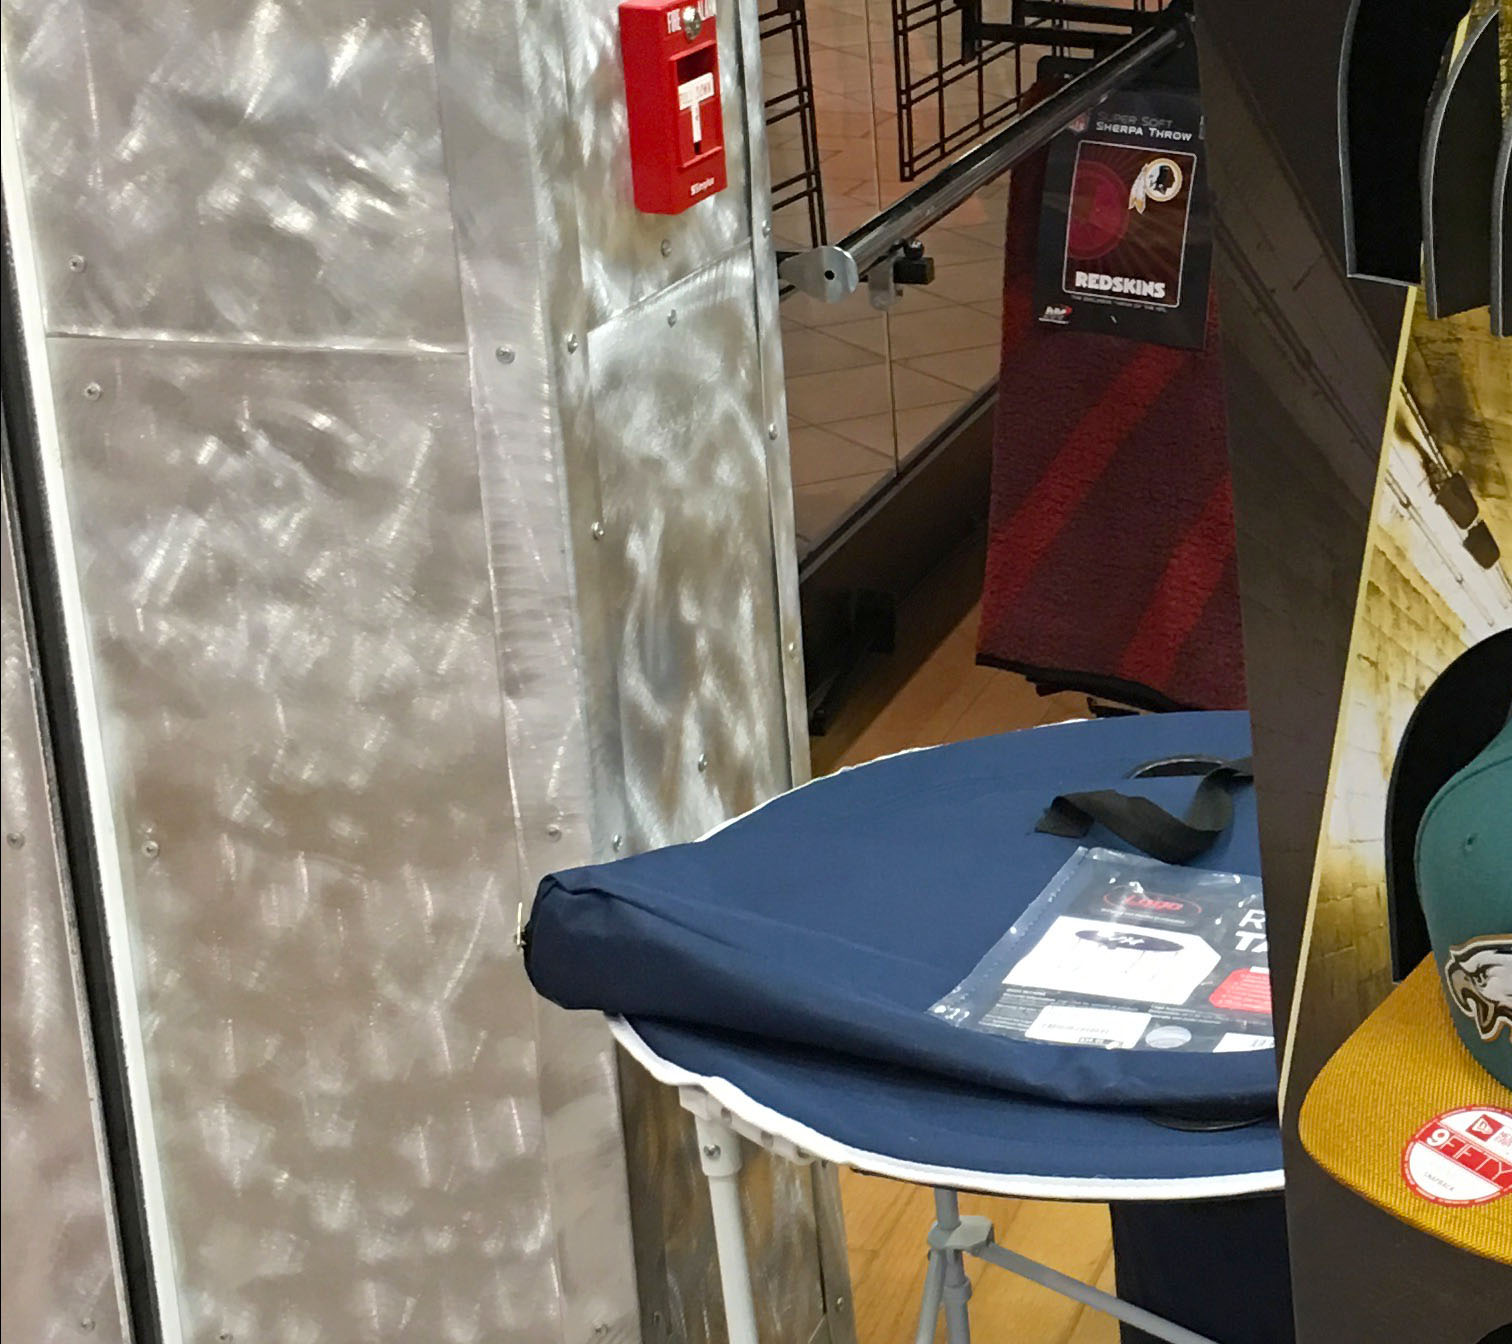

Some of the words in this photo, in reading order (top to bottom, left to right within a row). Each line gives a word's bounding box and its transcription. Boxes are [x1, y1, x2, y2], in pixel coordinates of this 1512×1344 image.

[1096, 121, 1144, 136] SHERPA
[1149, 127, 1193, 142] THROW
[1141, 116, 1174, 129] SOFT
[1075, 270, 1166, 299] REDSKINS
